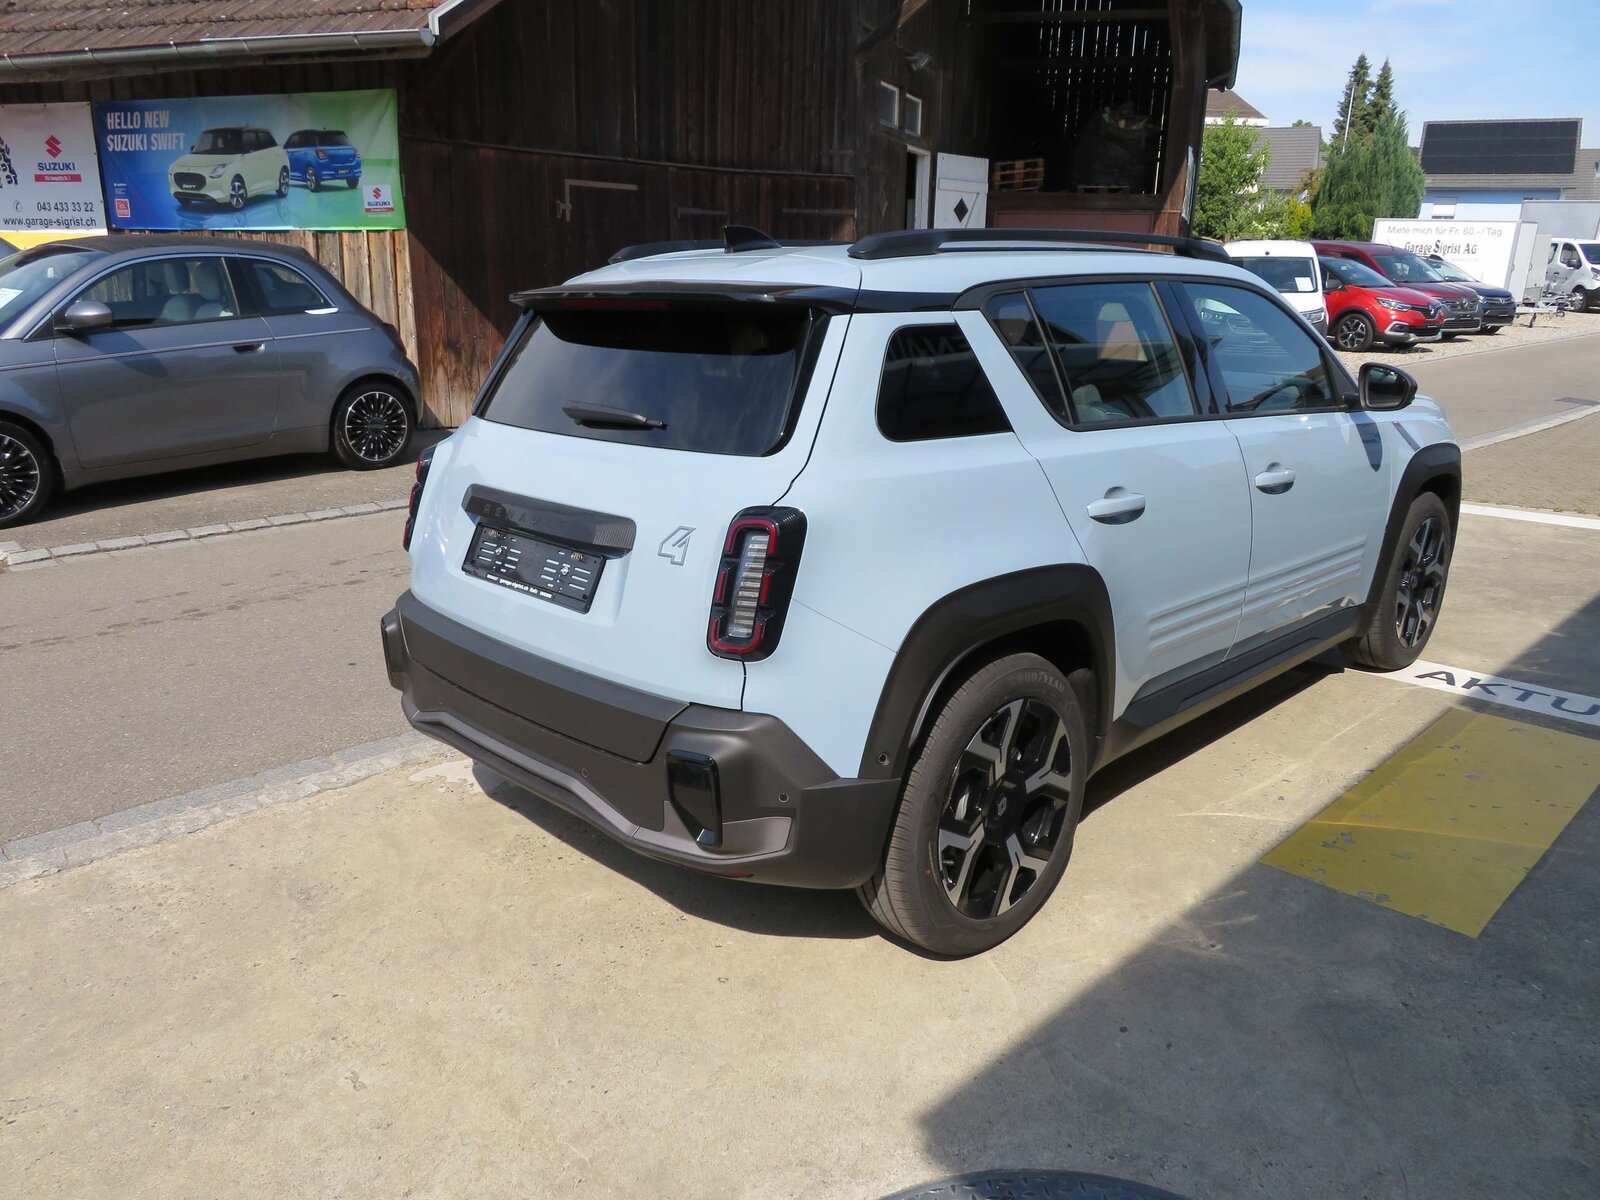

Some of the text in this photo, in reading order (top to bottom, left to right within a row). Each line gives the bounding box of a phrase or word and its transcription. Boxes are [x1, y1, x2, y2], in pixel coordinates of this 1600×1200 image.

[106, 110, 170, 130] HELLO NEW
[106, 132, 185, 151] SUZUKI SWIFT
[37, 162, 76, 171] SUZUKI
[37, 202, 94, 212] 043 433 33 22
[3, 217, 97, 228] www.garage-sigrist.ch
[1387, 226, 1411, 235] Miete
[1412, 226, 1433, 235] mich
[1435, 226, 1448, 235] für
[1487, 227, 1503, 238] Tag
[1405, 239, 1478, 256] Garage Sigrist AG
